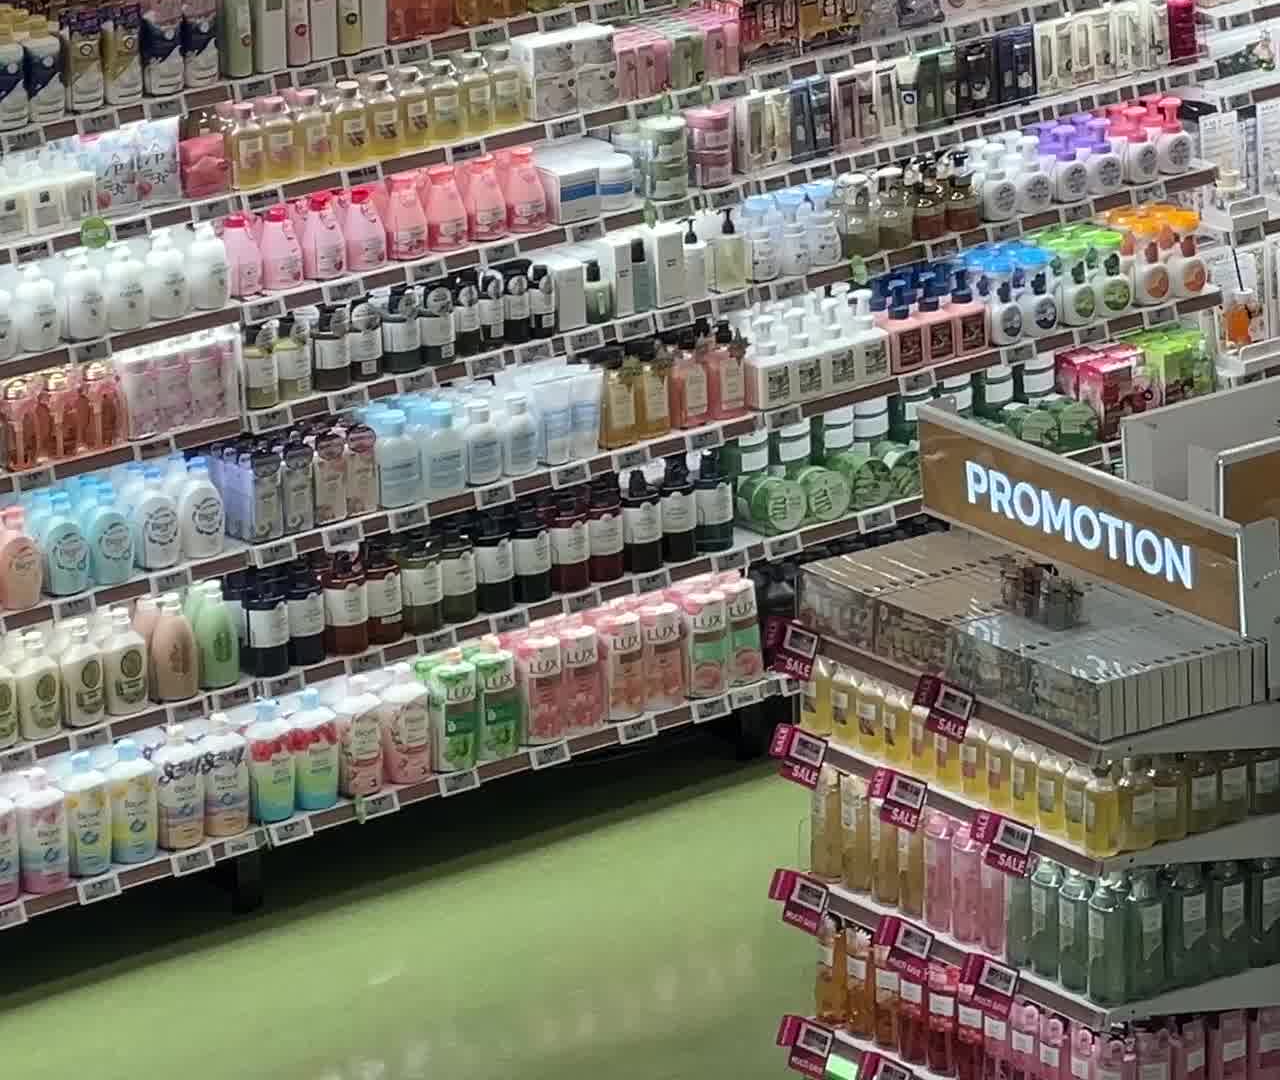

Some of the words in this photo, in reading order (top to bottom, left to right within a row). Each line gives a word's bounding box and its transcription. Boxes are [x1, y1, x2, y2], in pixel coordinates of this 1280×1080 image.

[964, 460, 1194, 586] PROMOTION
[612, 634, 640, 652] LUX
[565, 647, 595, 664] LUX
[529, 659, 559, 674] LUX
[785, 657, 811, 678] SALE
[938, 718, 966, 738] SALE
[791, 764, 819, 785] SALE
[891, 807, 920, 826] SALE
[997, 853, 1026, 873] SALE
